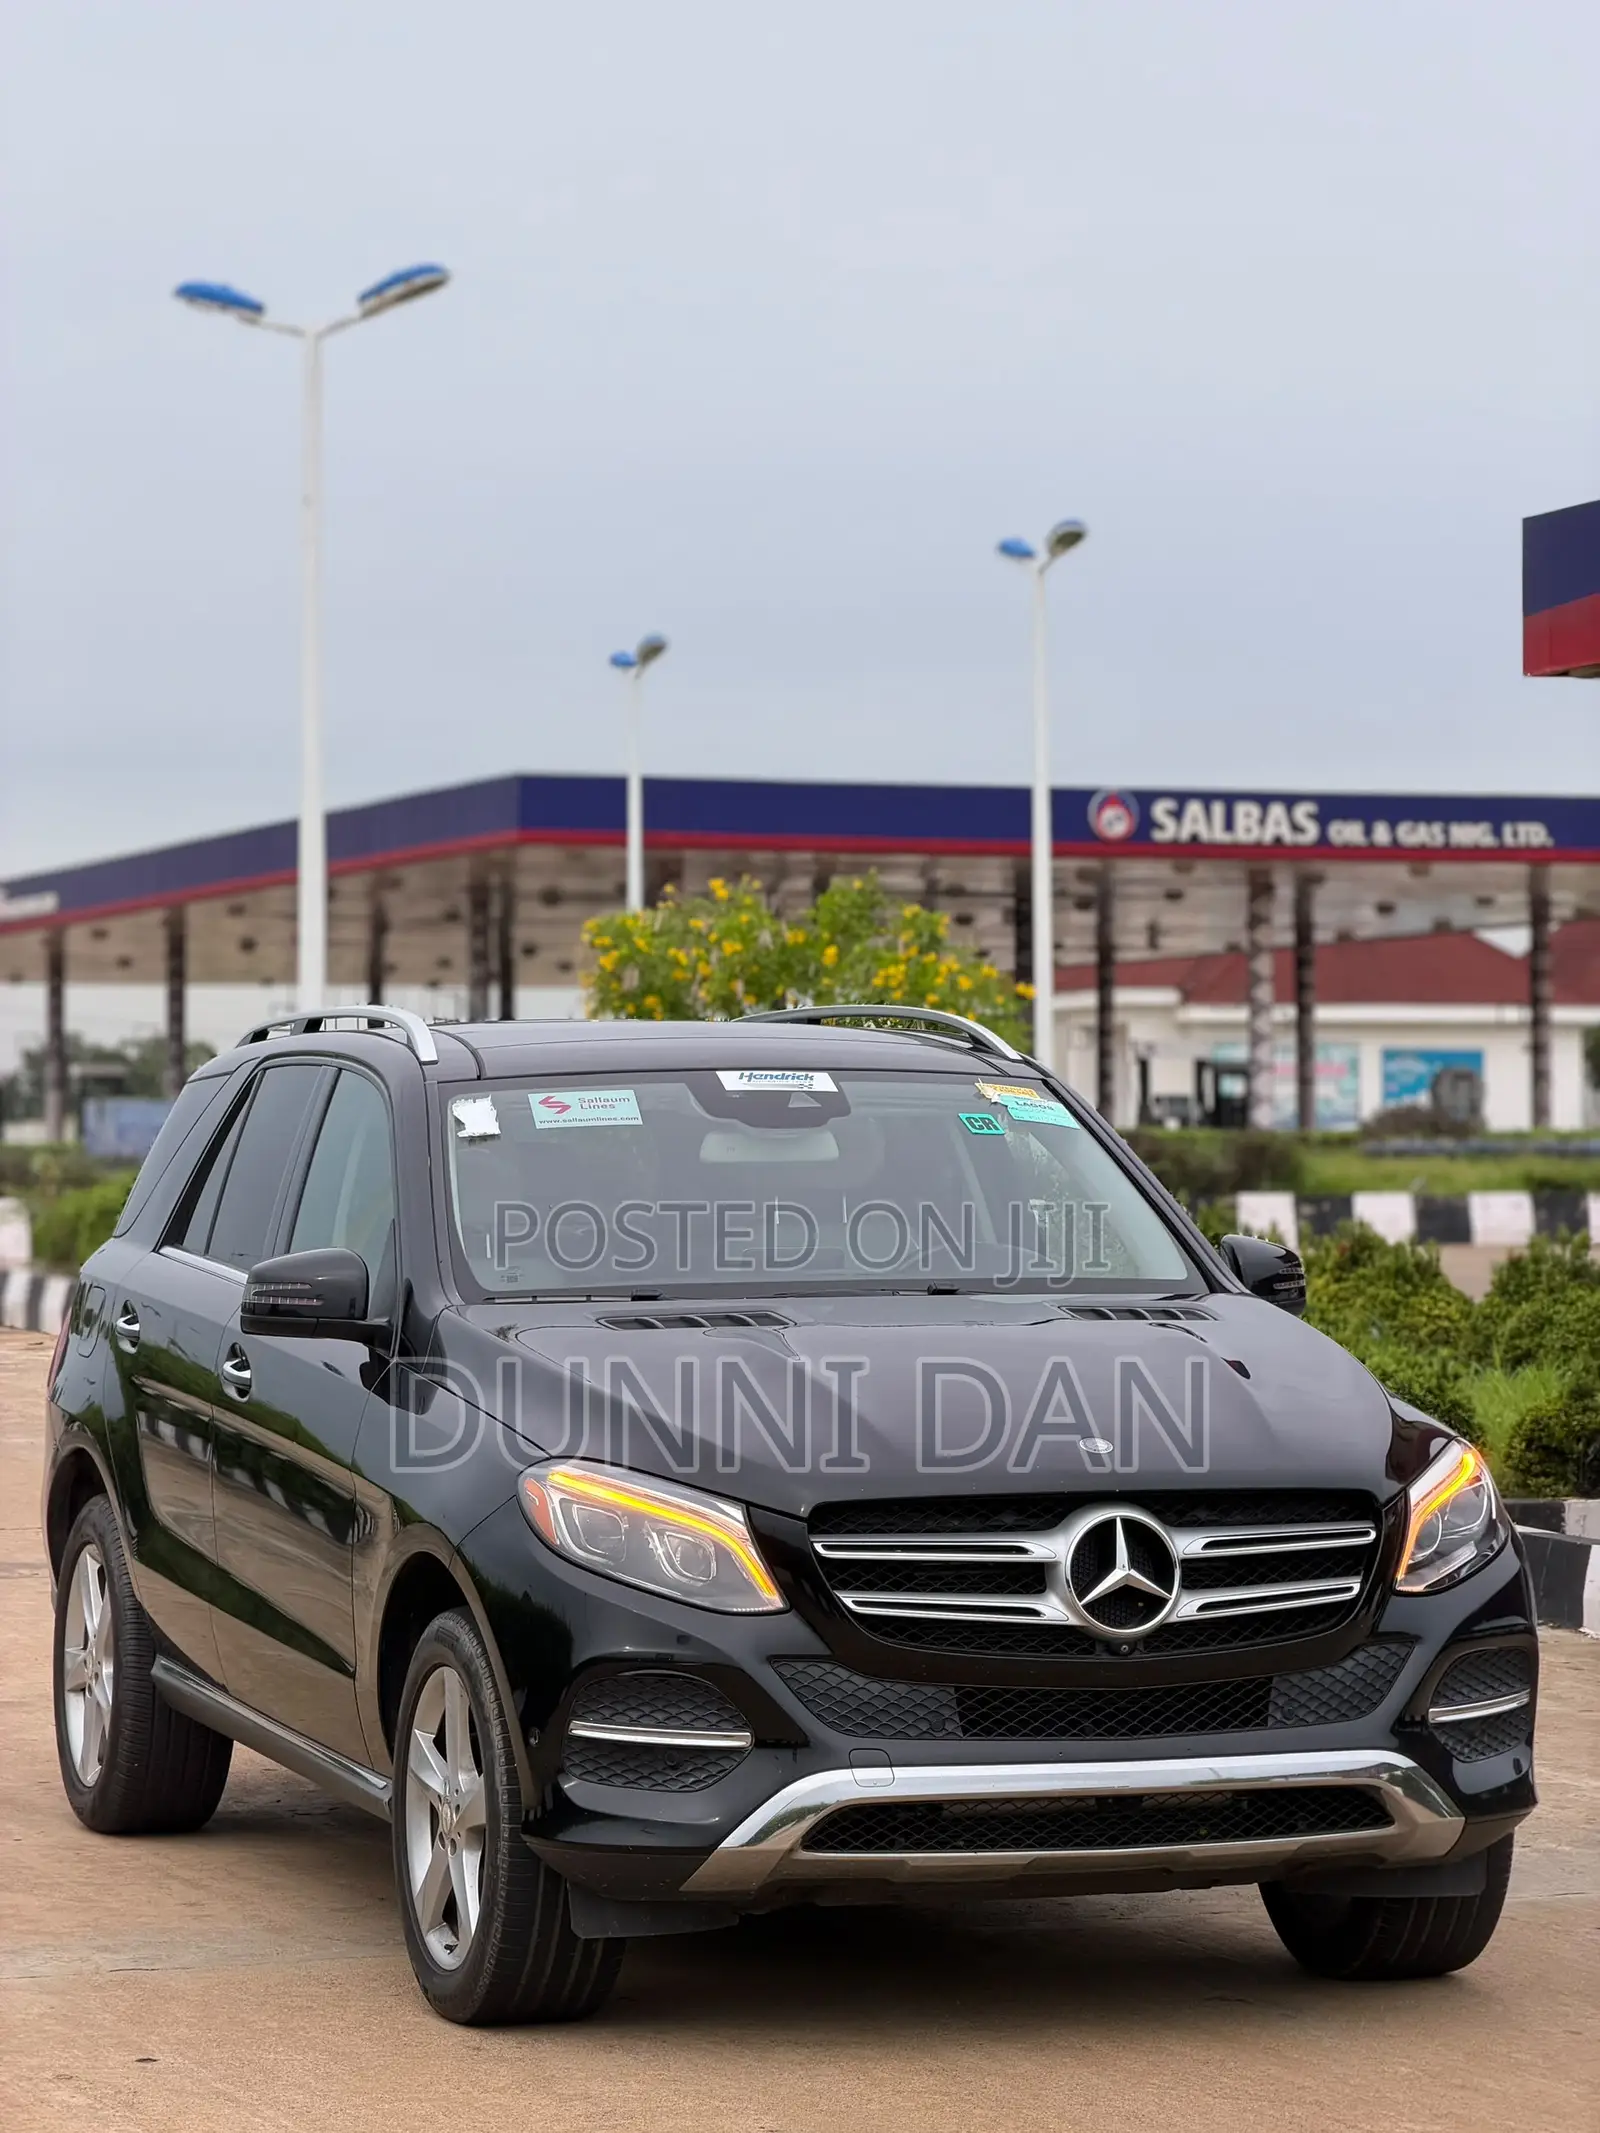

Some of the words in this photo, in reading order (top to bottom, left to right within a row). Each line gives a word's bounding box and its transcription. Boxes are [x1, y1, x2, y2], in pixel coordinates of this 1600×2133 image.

[1151, 797, 1320, 846] SALBAS
[1395, 820, 1446, 848] GAS
[1501, 820, 1555, 848] LTD.
[738, 1072, 815, 1083] Hendrick
[578, 1096, 631, 1104] Sallaum
[538, 1116, 640, 1125] www.sallaumlines.com
[965, 1116, 1001, 1131] CR
